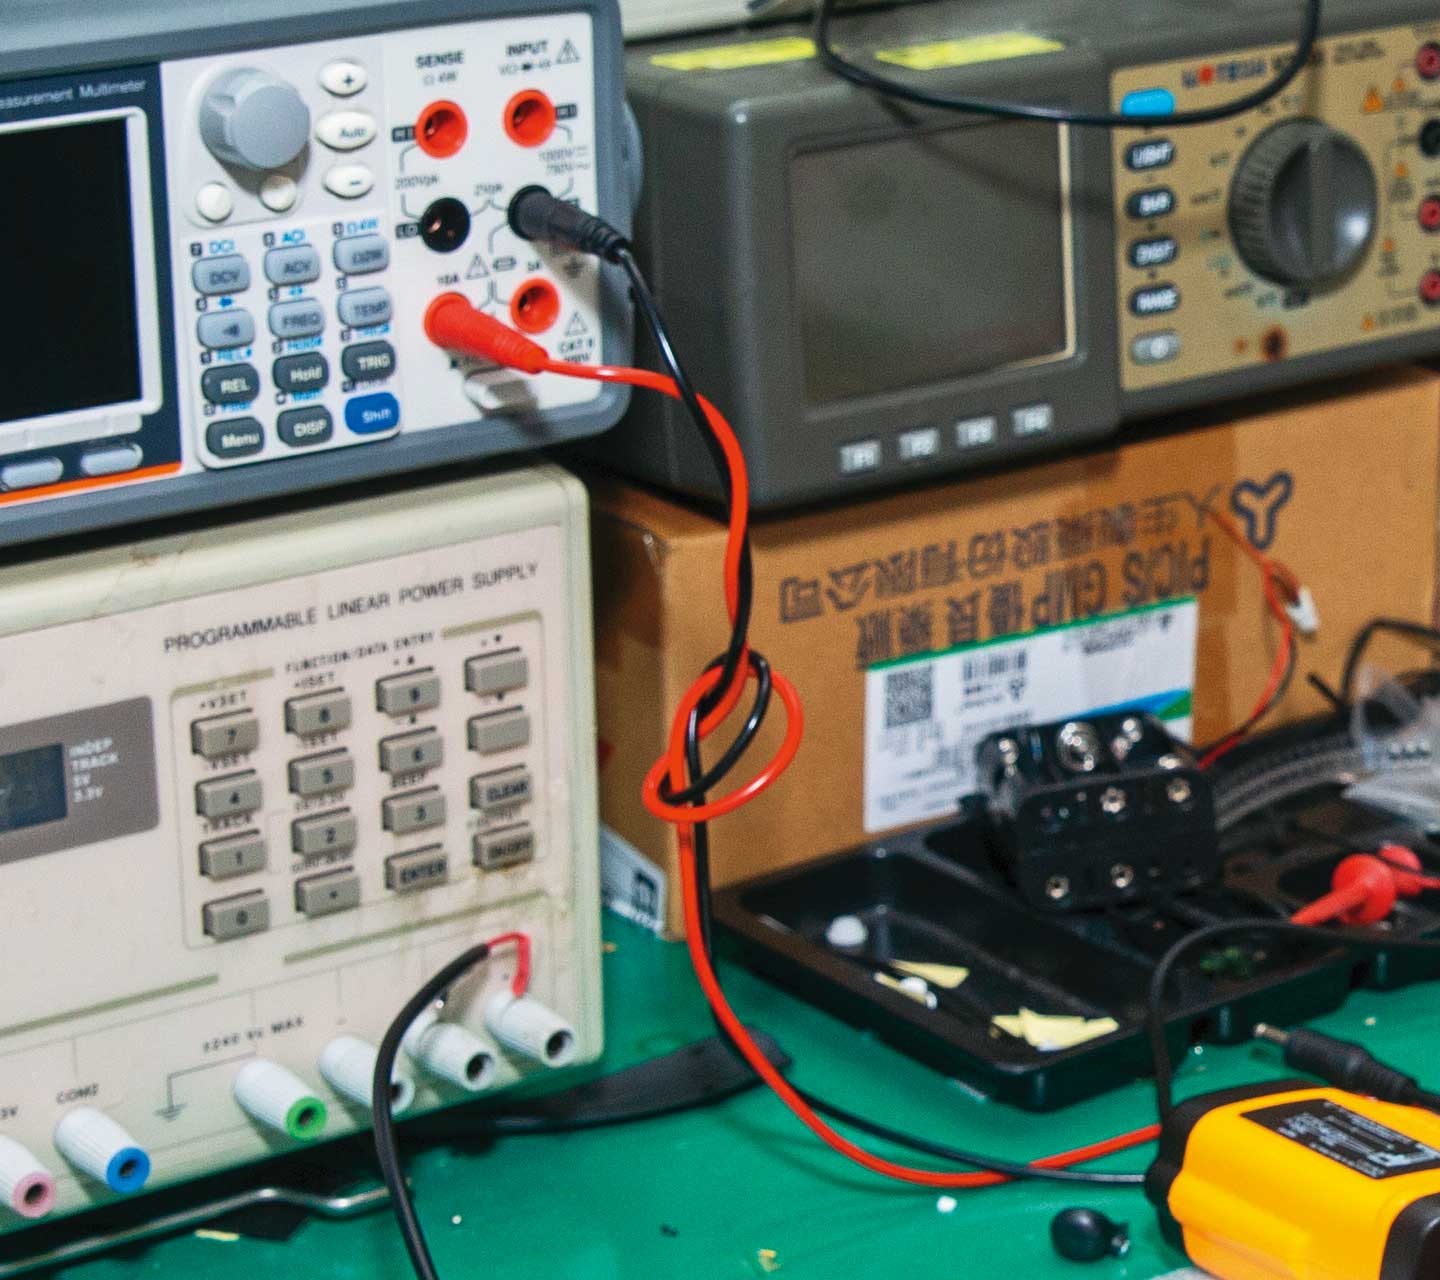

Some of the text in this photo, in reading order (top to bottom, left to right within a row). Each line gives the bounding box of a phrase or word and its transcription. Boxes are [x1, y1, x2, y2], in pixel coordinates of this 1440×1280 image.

[506, 41, 548, 56] INPUT
[416, 52, 464, 68] SENSE
[79, 77, 147, 100] Multimeter
[339, 123, 368, 140] Auto
[284, 261, 310, 275] ACV
[211, 270, 240, 285] DCV
[354, 300, 388, 316] TEMP
[357, 353, 391, 370] TRIG
[290, 366, 323, 383] Hold
[220, 378, 251, 394] REL
[362, 409, 392, 424] Shift
[294, 420, 328, 437] DISP
[221, 432, 260, 448] Menu
[164, 562, 539, 655] PROGRAMMABLE LINEAR POWER SUPPLY
[285, 631, 434, 674] FUNCTION/DATA ENTRY
[225, 729, 238, 745] 7
[69, 738, 113, 758] INDEP
[71, 753, 119, 772] TRACK
[73, 772, 91, 787] 5V
[74, 787, 103, 804] 3.3V
[230, 790, 241, 804] 4
[486, 782, 529, 803] CLEAR
[325, 826, 337, 845] 2
[399, 860, 446, 885] ENTER
